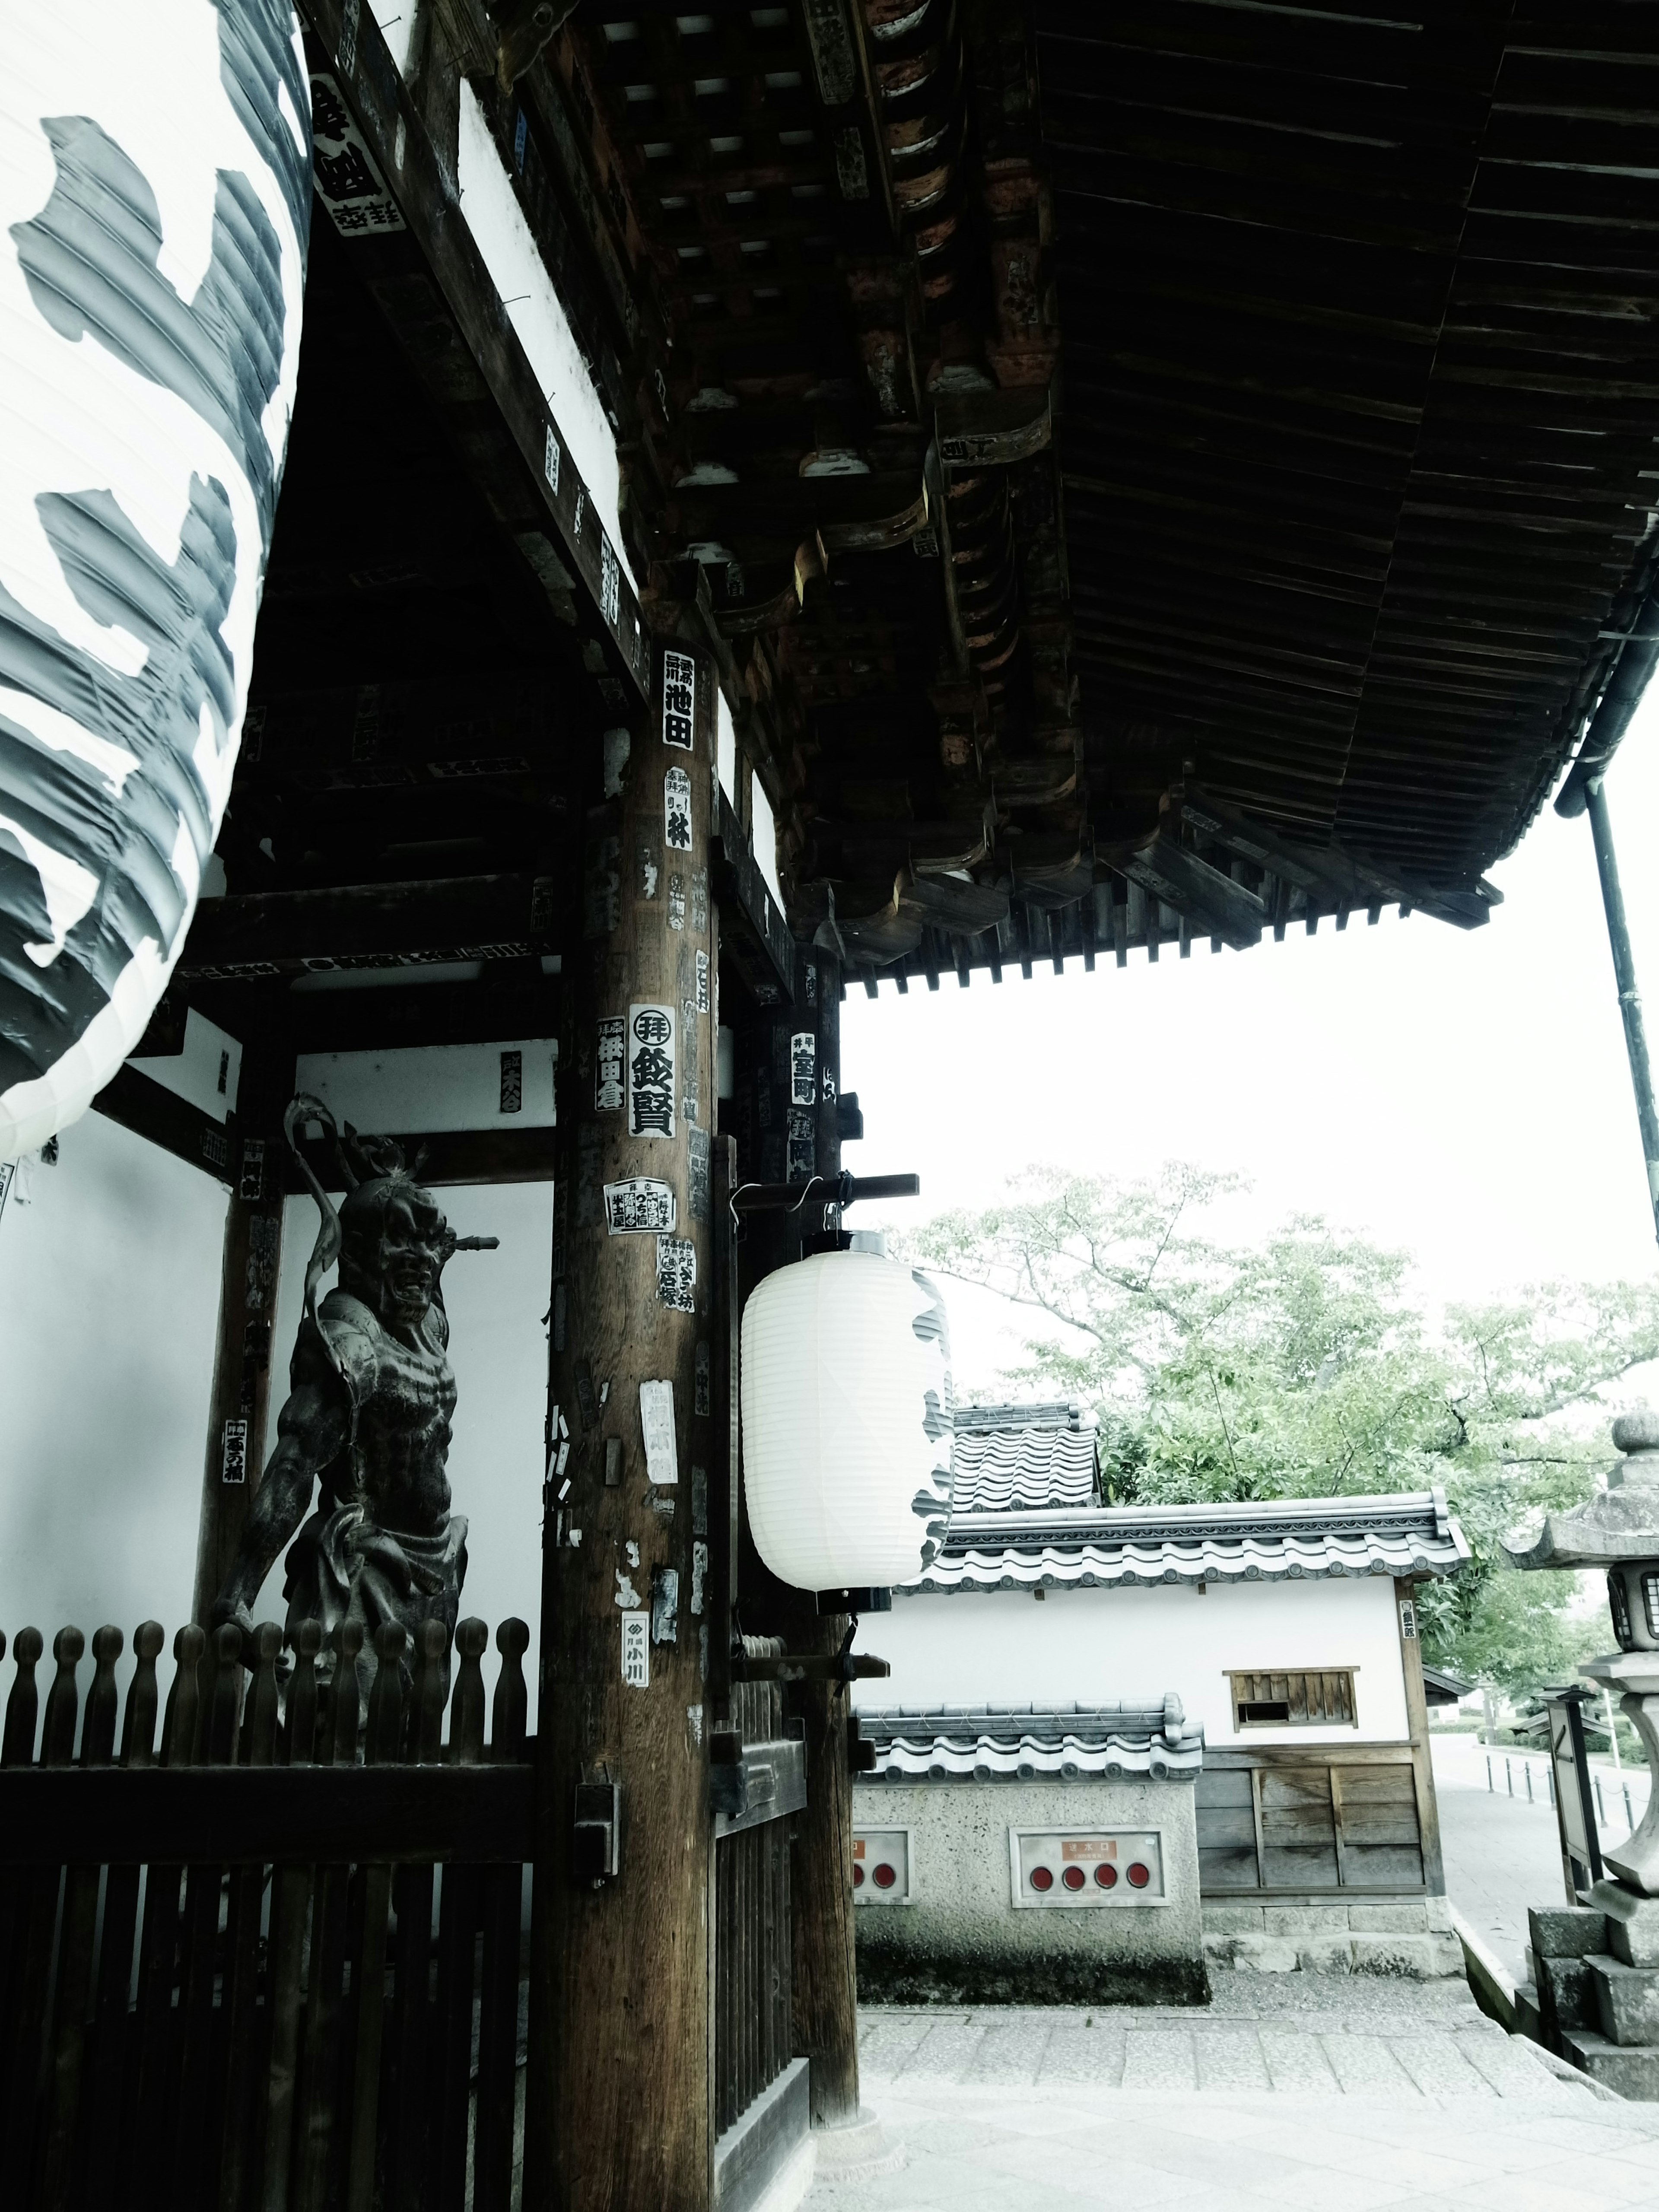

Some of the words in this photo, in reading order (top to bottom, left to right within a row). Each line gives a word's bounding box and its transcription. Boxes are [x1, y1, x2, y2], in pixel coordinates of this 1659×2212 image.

[665, 684, 692, 748] 池田
[668, 812, 690, 849] 林
[627, 1648, 643, 1680] 小川
